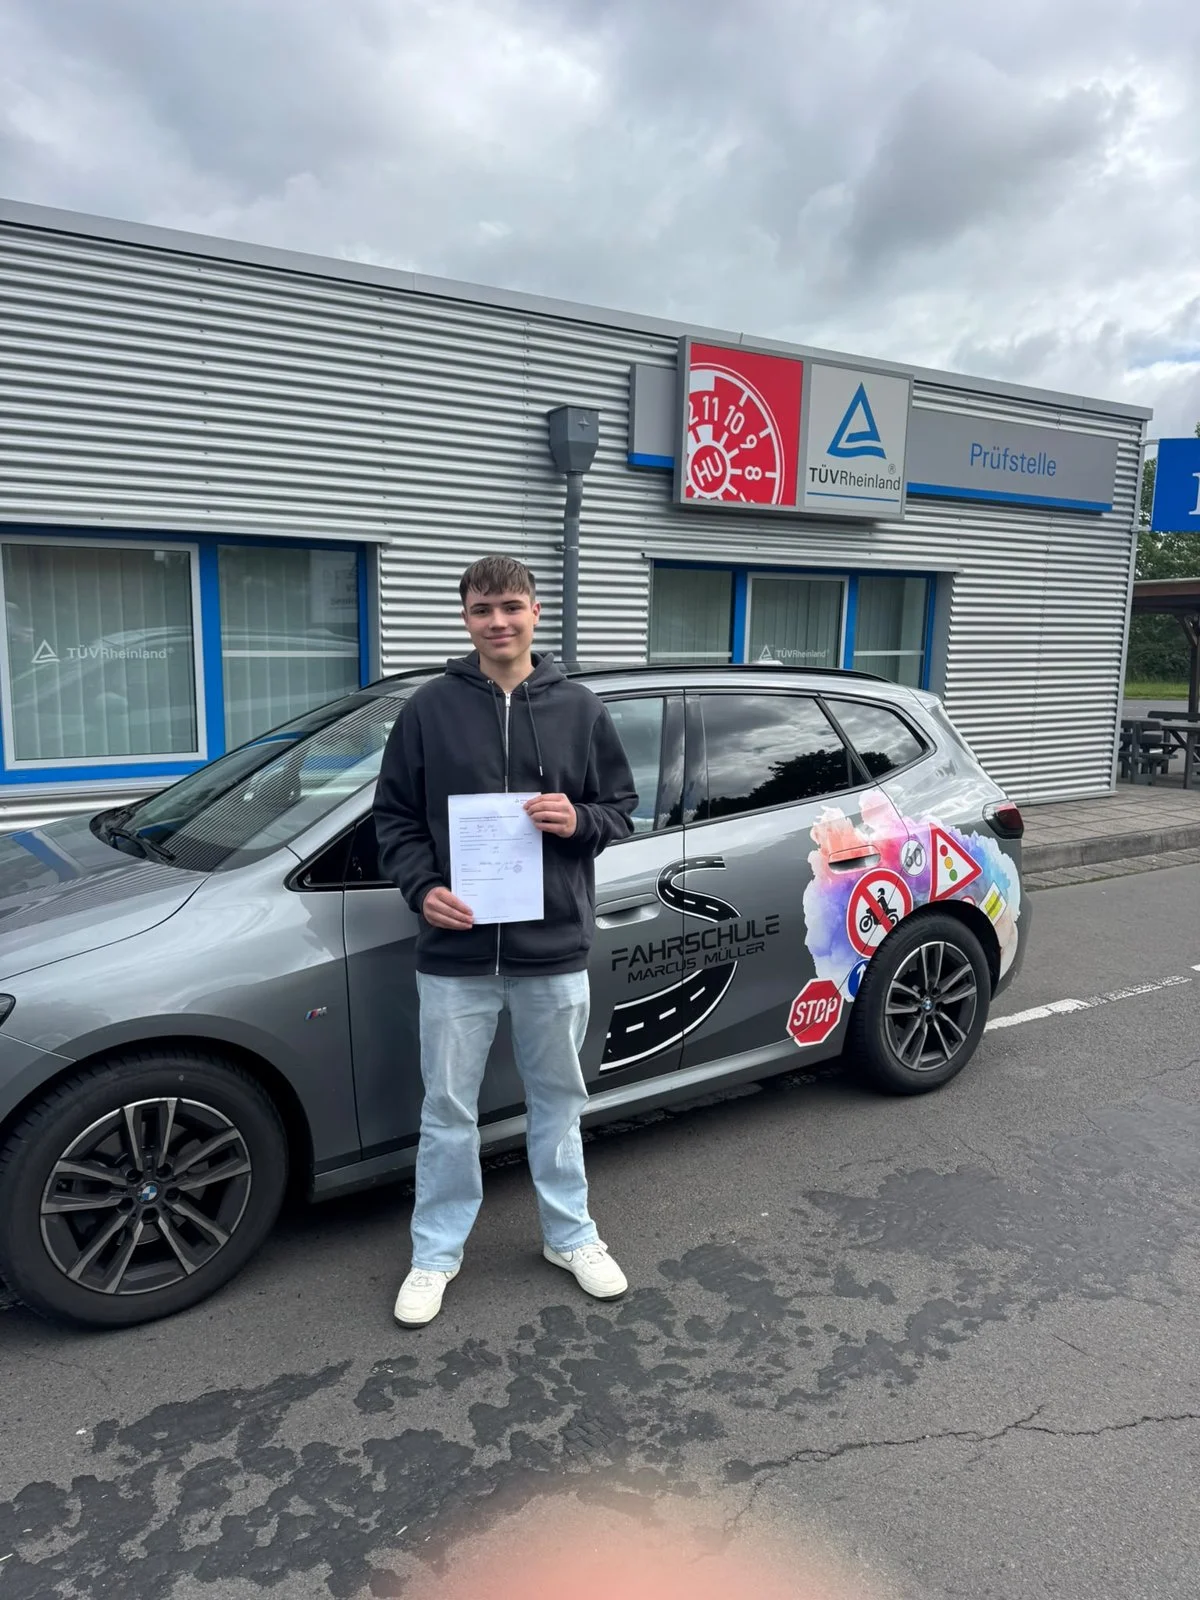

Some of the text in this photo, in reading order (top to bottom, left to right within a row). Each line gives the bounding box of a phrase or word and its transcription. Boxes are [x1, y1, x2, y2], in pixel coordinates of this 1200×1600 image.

[702, 396, 719, 421] 11
[724, 405, 745, 435] 10
[740, 434, 758, 449] 9
[693, 451, 723, 488] HU
[744, 465, 762, 481] 8
[970, 442, 1057, 477] Prüfstelle
[904, 847, 923, 867] 60
[611, 914, 780, 971] FAHRSCHULE
[627, 941, 765, 984] MARCUS MÜLLER
[793, 997, 838, 1027] STOP
